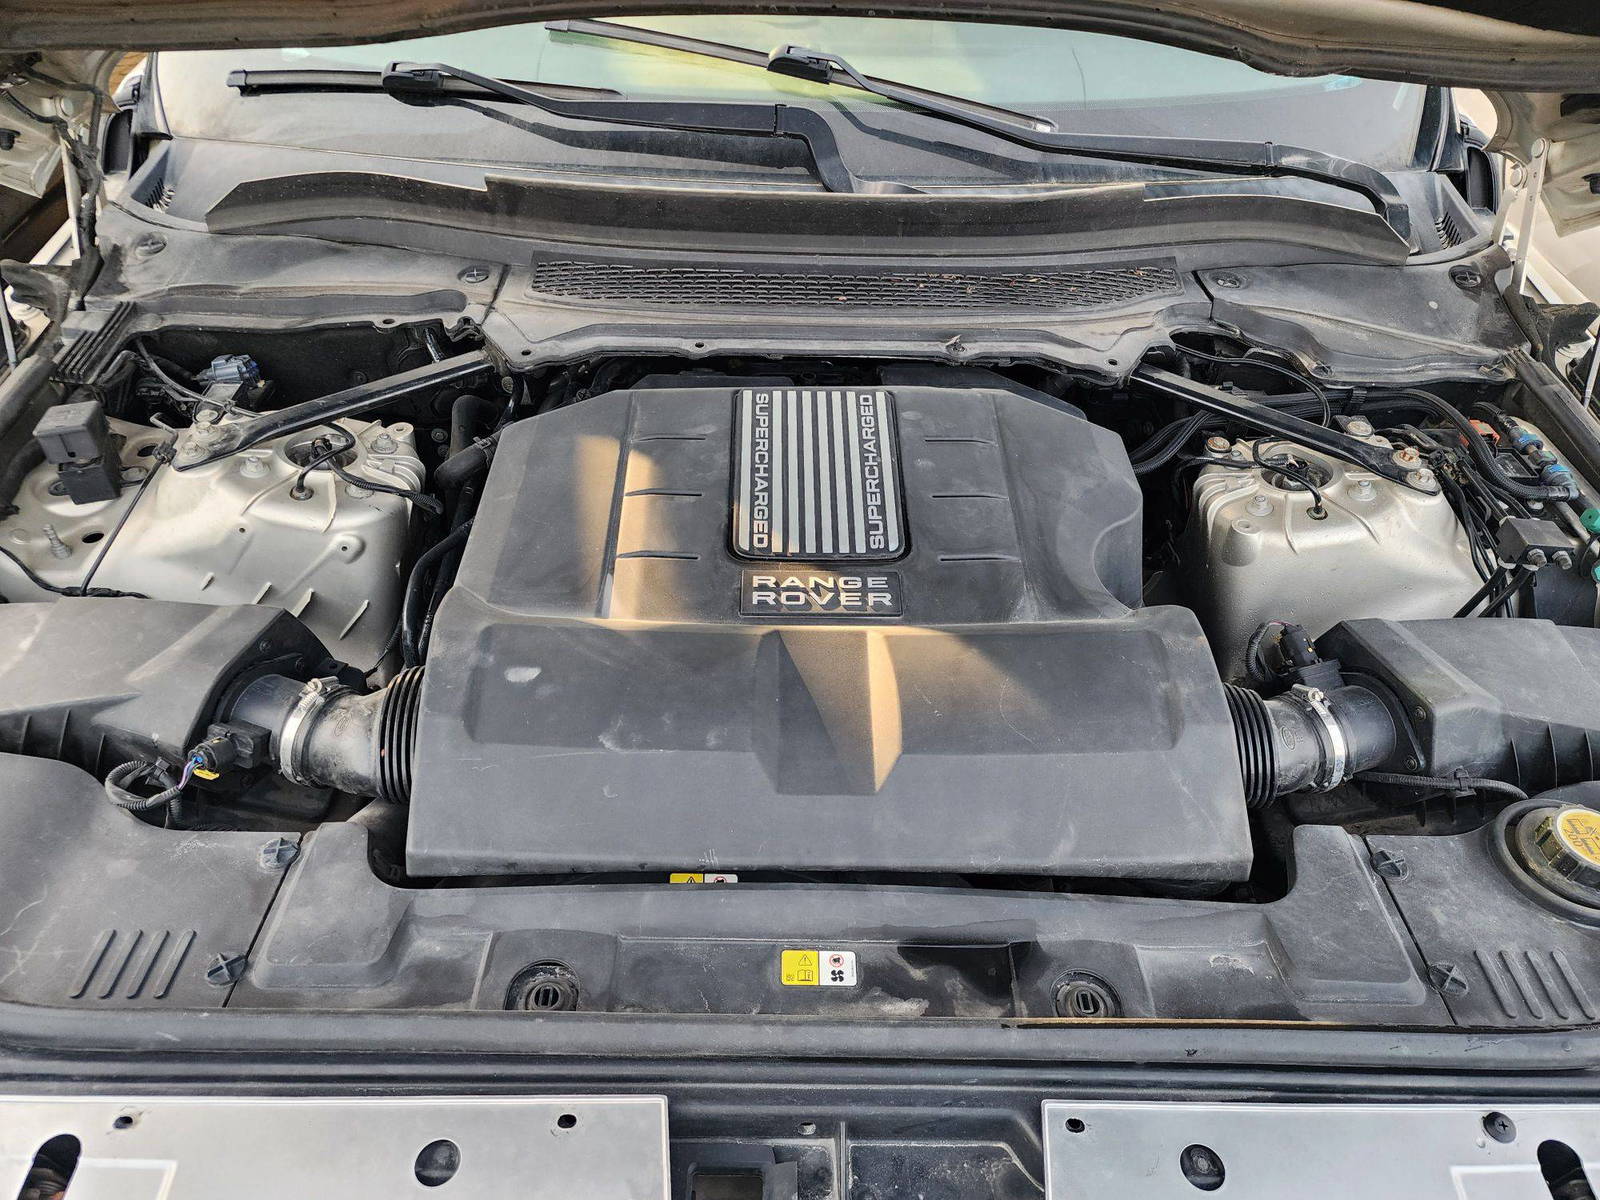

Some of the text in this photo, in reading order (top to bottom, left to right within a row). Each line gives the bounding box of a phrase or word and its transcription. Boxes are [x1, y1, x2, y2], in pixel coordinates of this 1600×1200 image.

[752, 392, 769, 549] SUPERCHARGED
[859, 394, 885, 550] SUPERCHARGED
[752, 575, 889, 589] RANGE
[752, 591, 893, 606] ROVER
